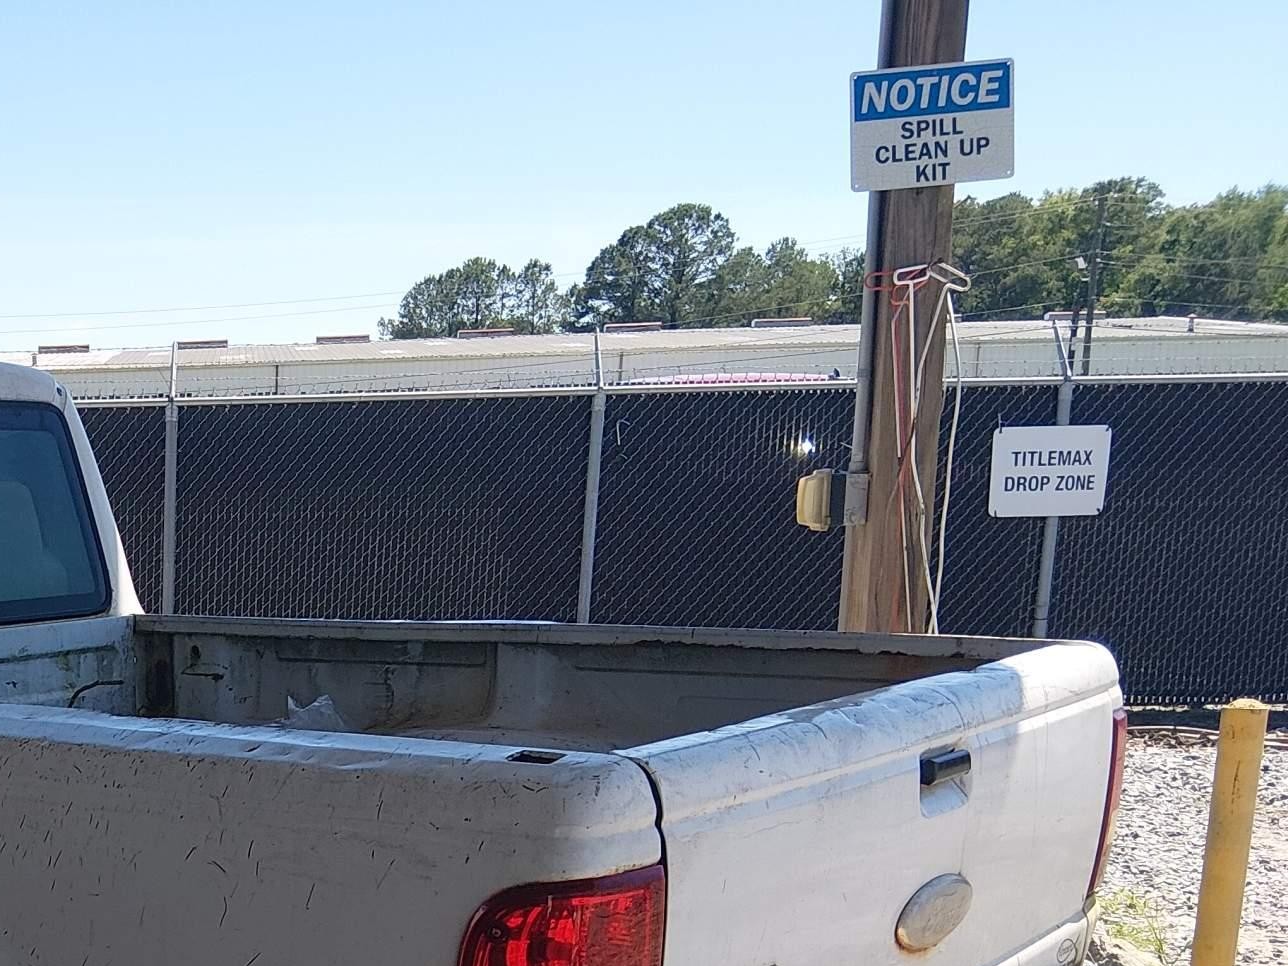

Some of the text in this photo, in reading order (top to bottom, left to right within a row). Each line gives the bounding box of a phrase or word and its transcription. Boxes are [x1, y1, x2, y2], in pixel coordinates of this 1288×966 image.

[860, 69, 1004, 114] NOTICE
[900, 116, 964, 140] SPILL
[875, 136, 990, 164] CLEAN UP
[915, 162, 951, 183] KIT
[1011, 449, 1093, 467] TITLEMAX
[1003, 474, 1096, 492] DROP ZONE
